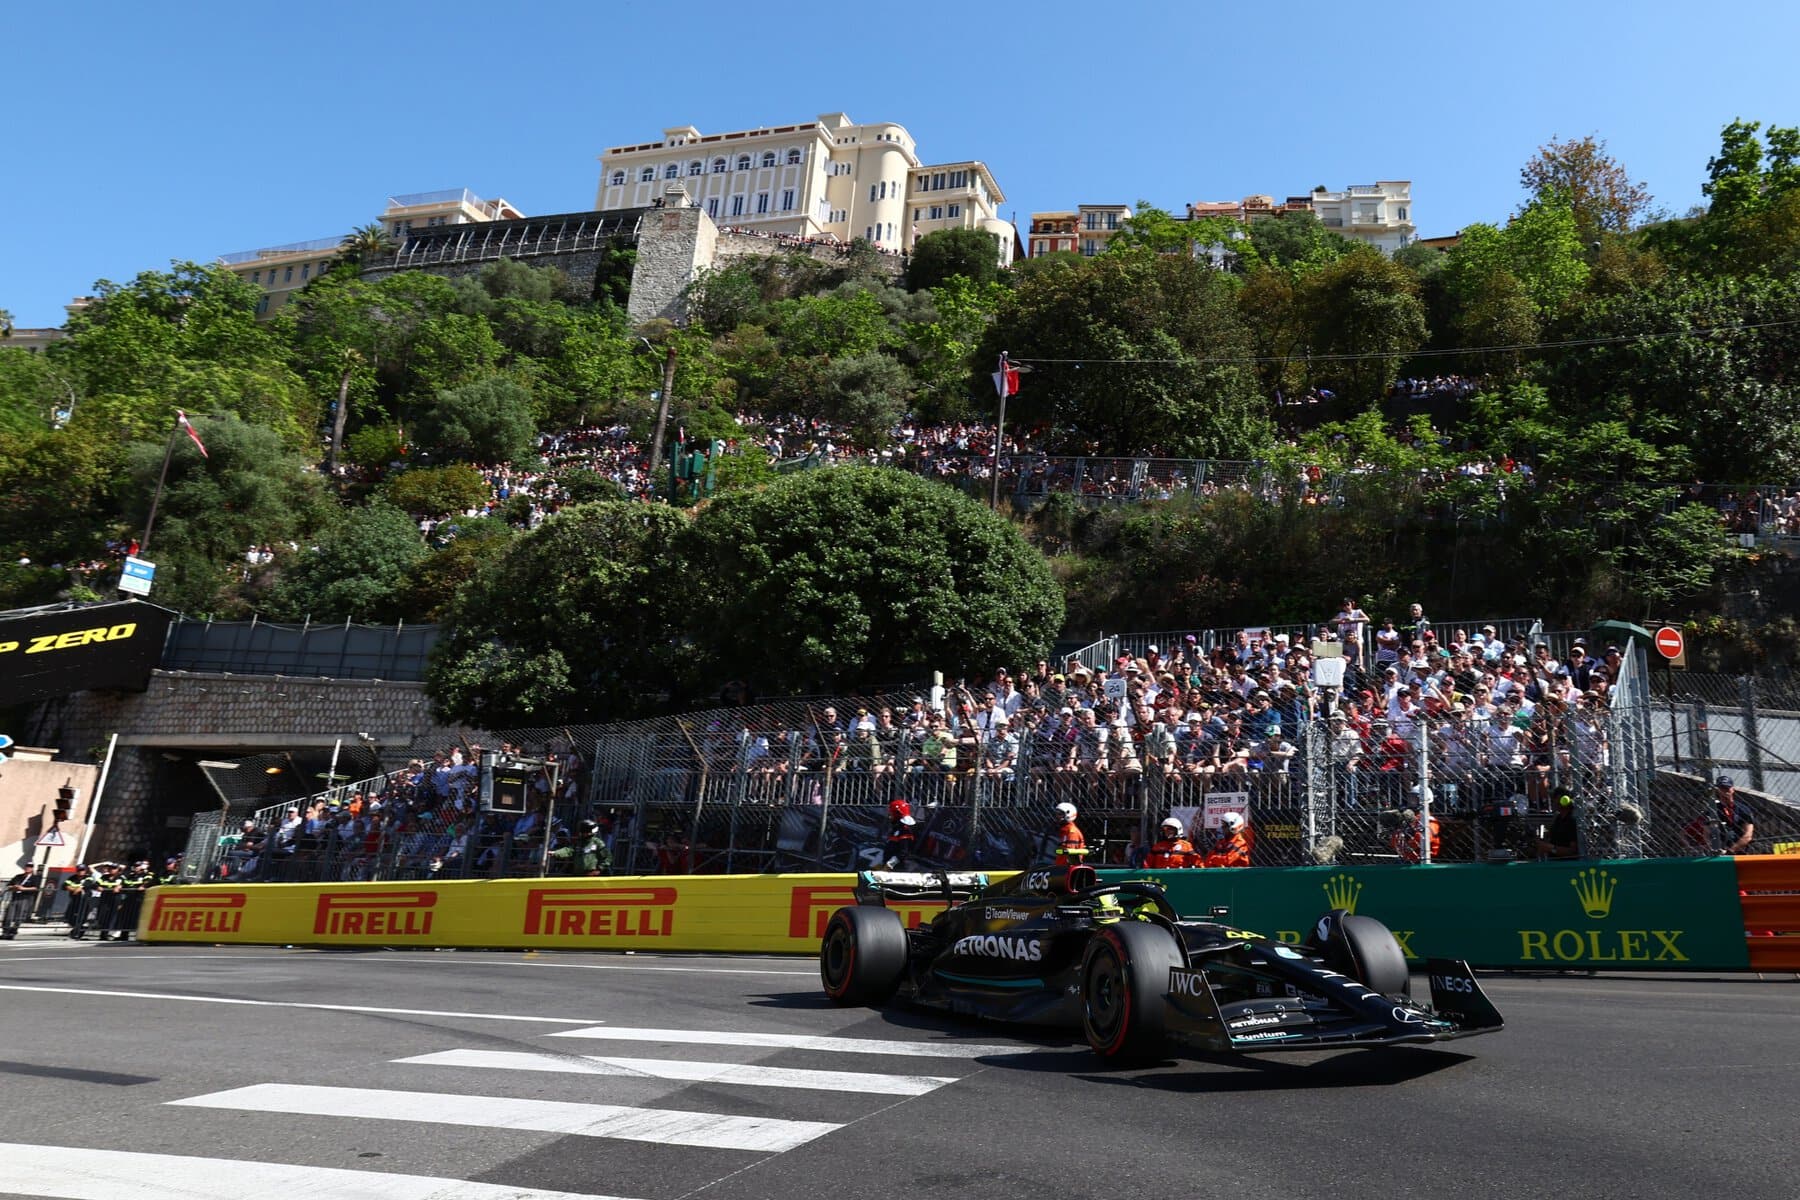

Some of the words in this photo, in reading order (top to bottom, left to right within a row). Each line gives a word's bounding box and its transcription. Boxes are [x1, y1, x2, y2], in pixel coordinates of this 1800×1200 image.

[25, 623, 137, 654] ZERO
[147, 893, 247, 932] PIRELLI
[313, 891, 438, 935] PIRELLI
[524, 887, 678, 936] PIRELLI
[992, 908, 1030, 920] TeamViewer
[954, 935, 1042, 961] PETRONAS
[1518, 930, 1690, 961] ROLEX
[1169, 971, 1203, 997] IWC
[1431, 976, 1472, 993] INEOS
[1230, 1017, 1280, 1028] PETRONAS
